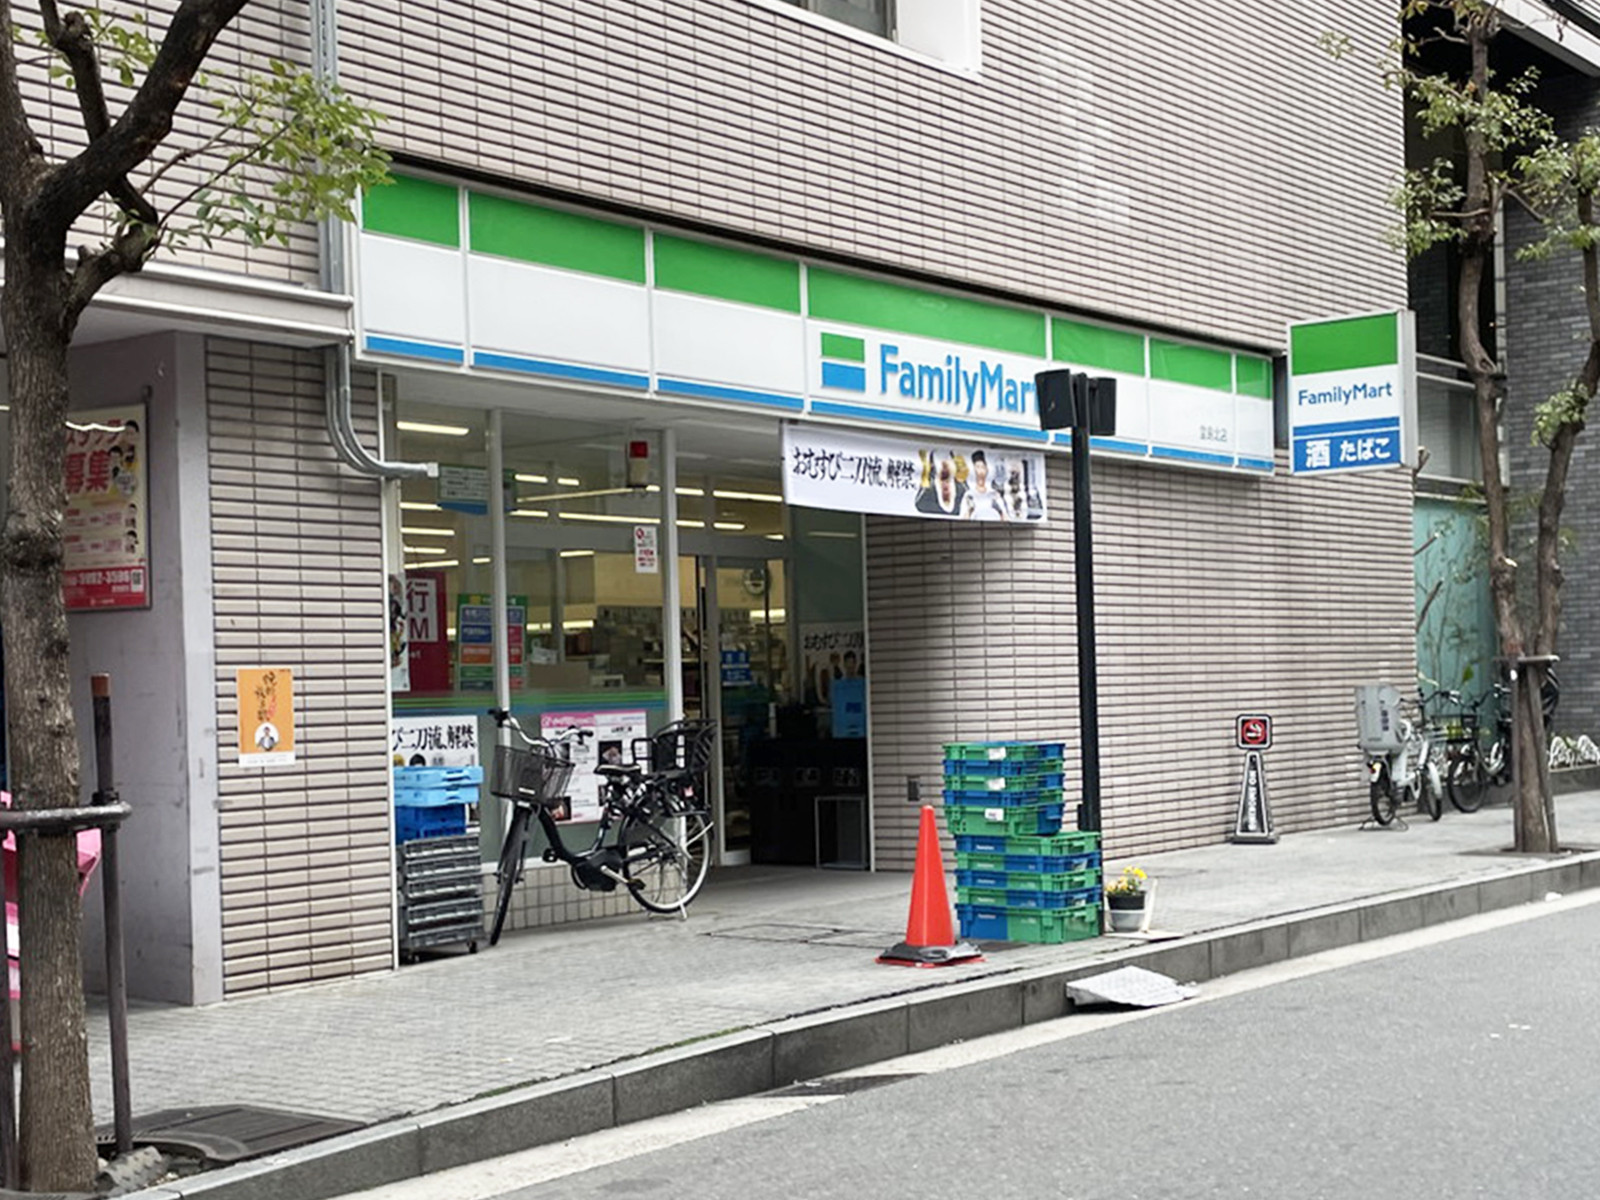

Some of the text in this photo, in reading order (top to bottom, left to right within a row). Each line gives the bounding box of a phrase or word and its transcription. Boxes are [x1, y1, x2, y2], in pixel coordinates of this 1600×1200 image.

[880, 343, 1039, 413] FamilyMar
[1298, 382, 1393, 405] FamilyMart
[1305, 437, 1391, 468] 酒 たばこ
